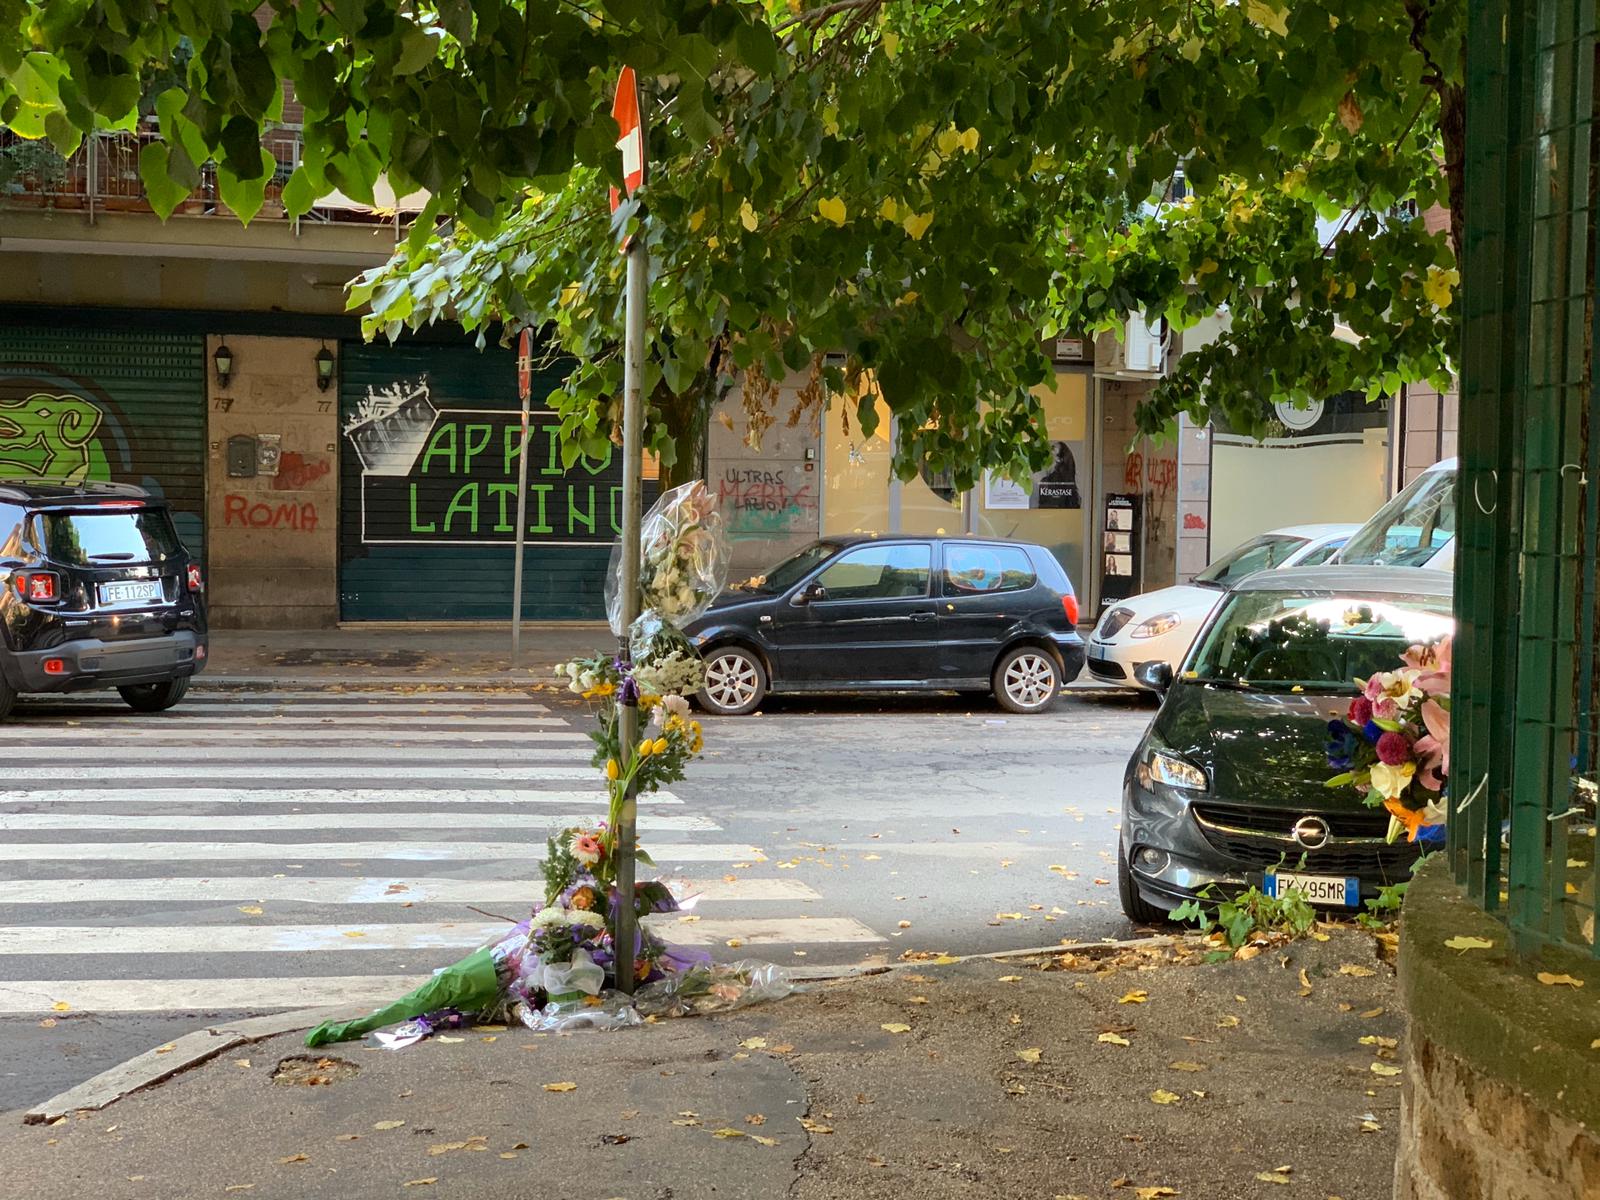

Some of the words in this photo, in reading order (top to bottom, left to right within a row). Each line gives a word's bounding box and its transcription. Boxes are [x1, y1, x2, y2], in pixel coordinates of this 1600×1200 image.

[317, 400, 333, 412] 77
[726, 468, 785, 485] ULTRAS
[224, 494, 319, 533] ROMA
